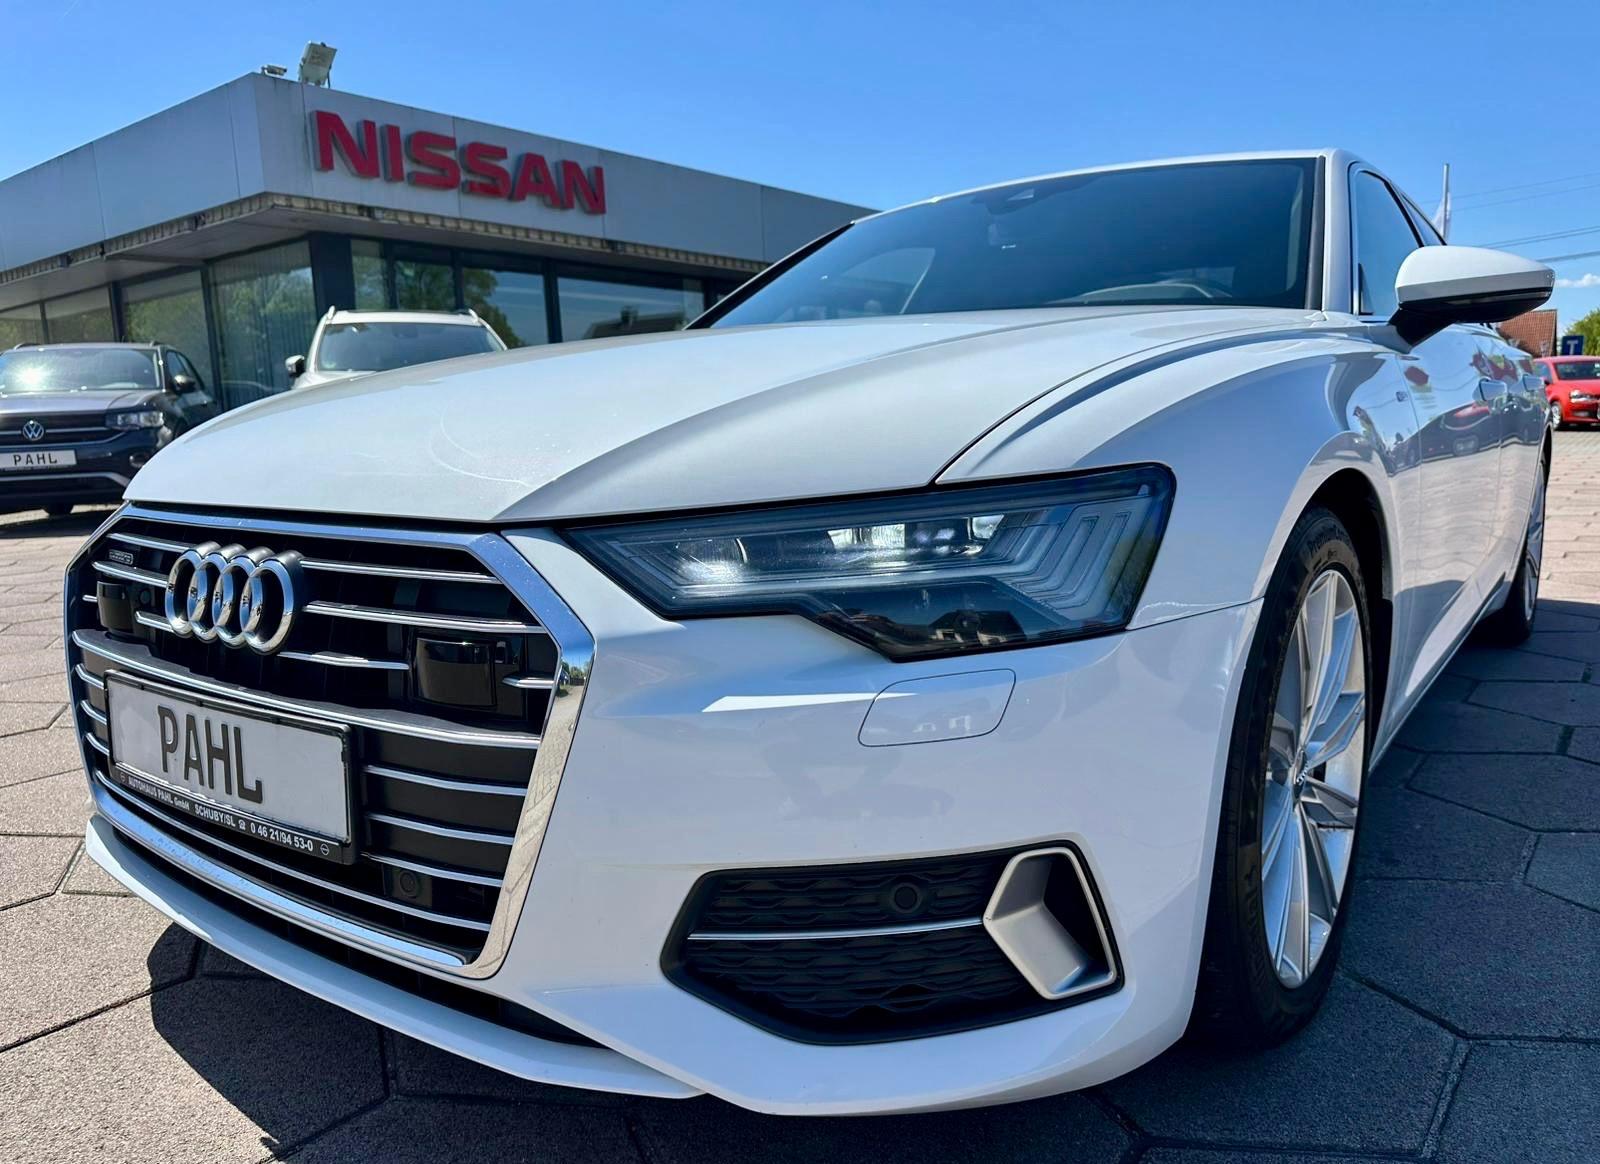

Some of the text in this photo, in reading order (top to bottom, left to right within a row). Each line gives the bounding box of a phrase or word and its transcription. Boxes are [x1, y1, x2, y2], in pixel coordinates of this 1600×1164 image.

[310, 110, 606, 215] NISSAN
[13, 452, 58, 466] PAHL
[157, 705, 264, 804] PAHL
[194, 803, 236, 828] SCHUBY/SL
[250, 822, 256, 834] 0
[257, 824, 269, 838] 46
[269, 828, 293, 846] 21/94
[293, 837, 314, 852] 53-0
